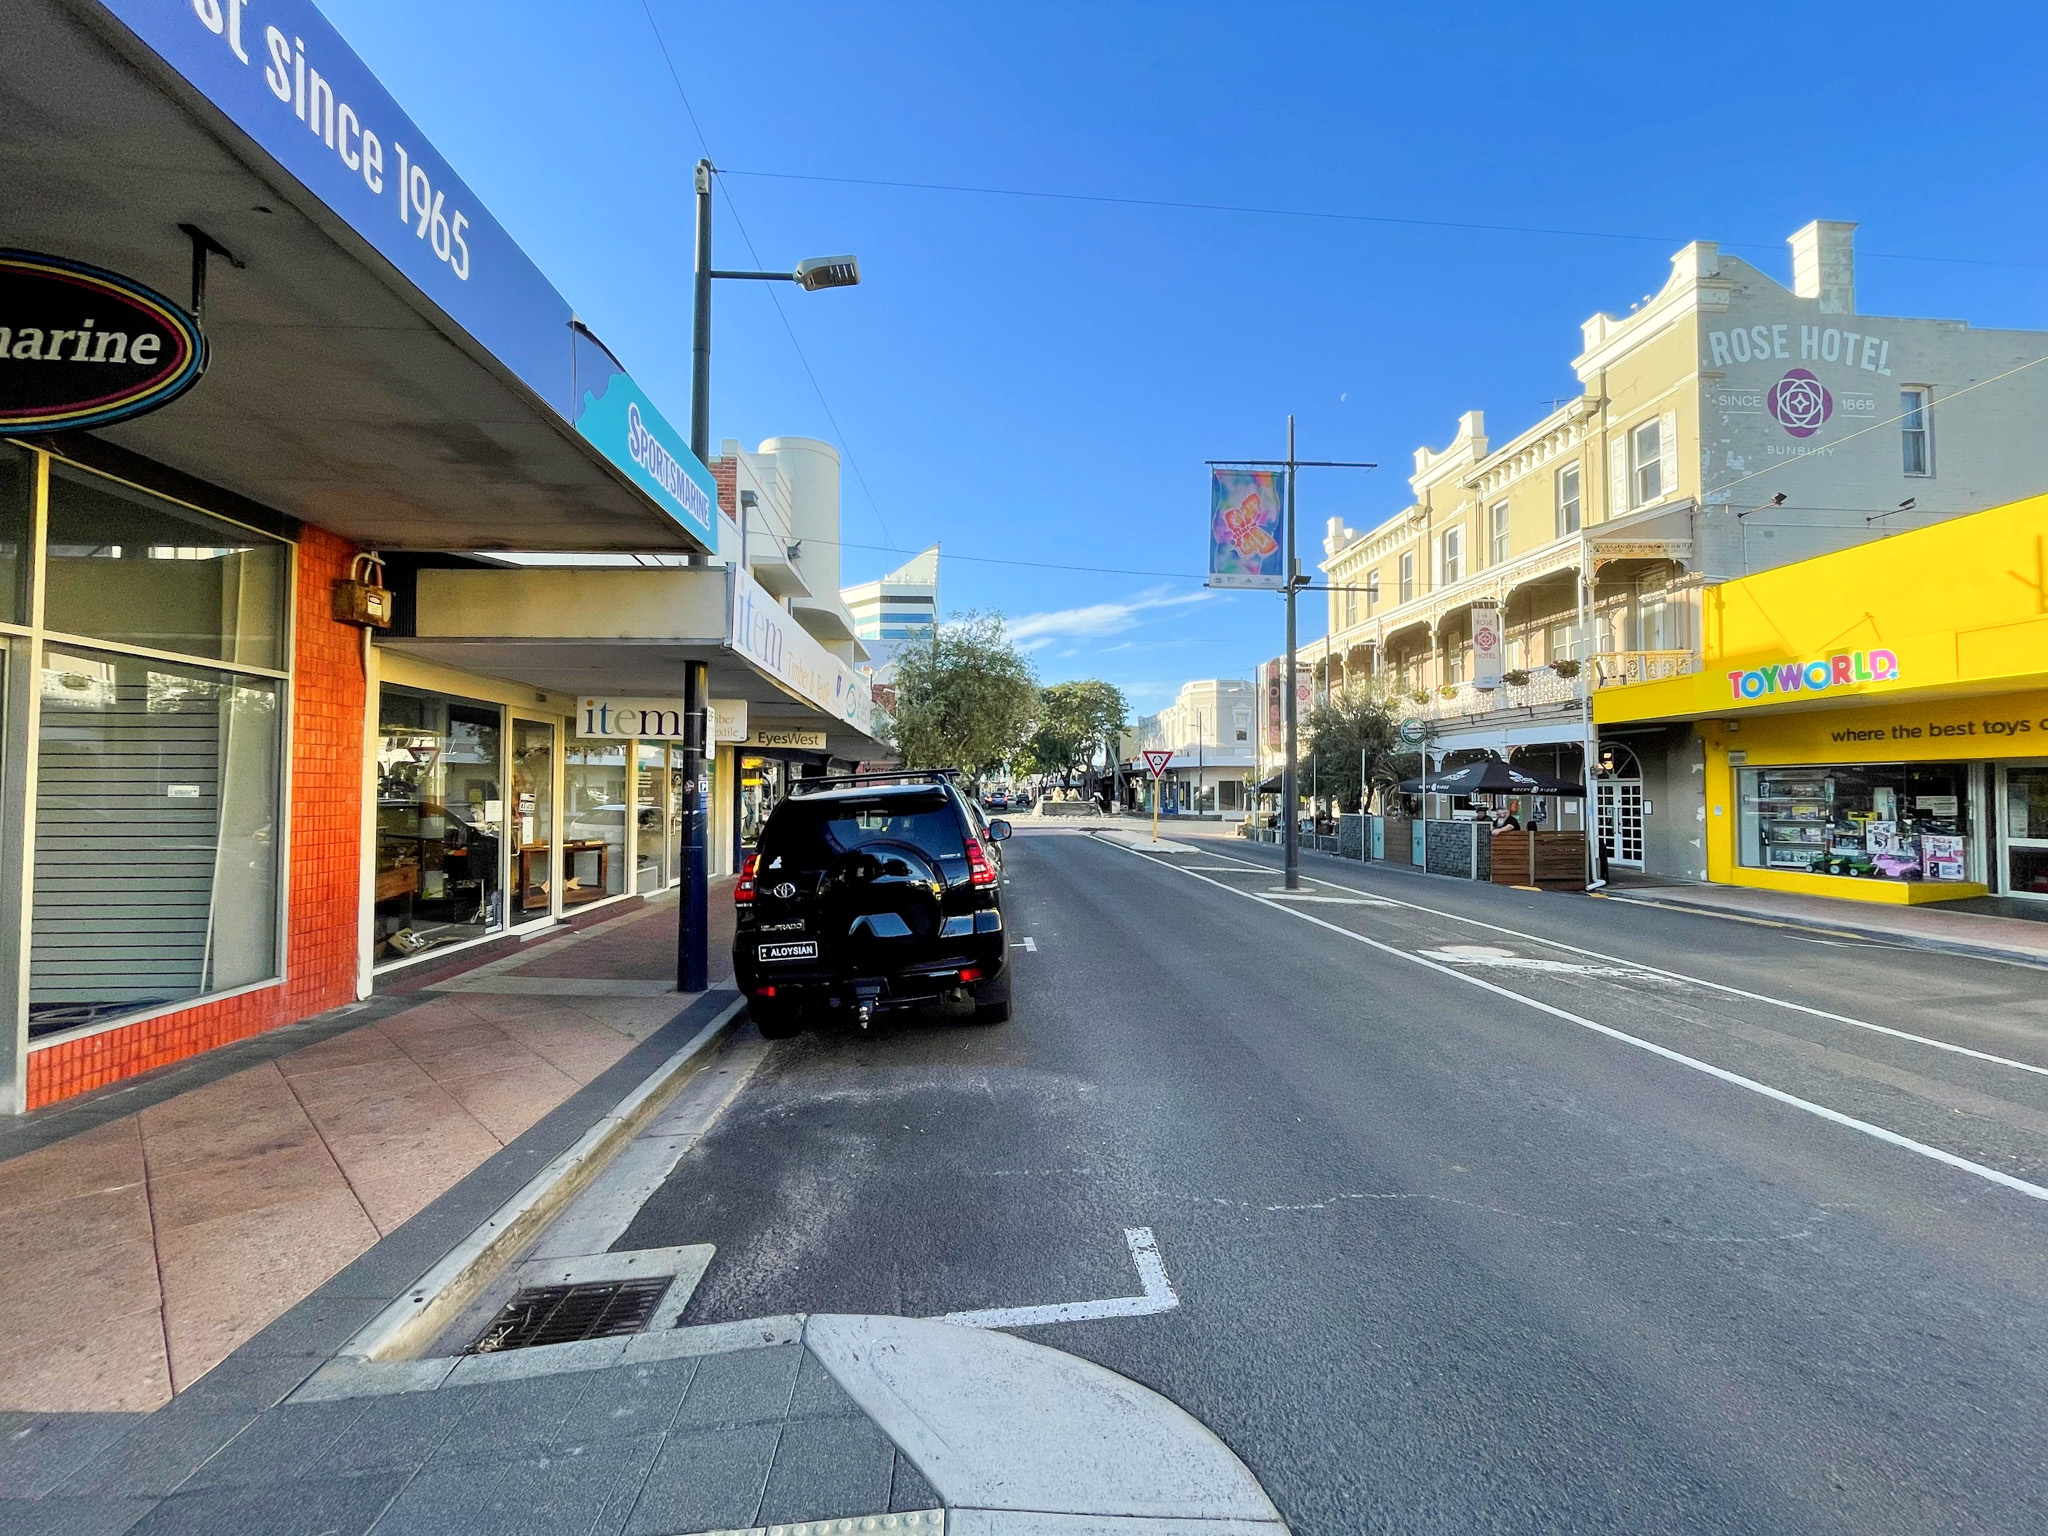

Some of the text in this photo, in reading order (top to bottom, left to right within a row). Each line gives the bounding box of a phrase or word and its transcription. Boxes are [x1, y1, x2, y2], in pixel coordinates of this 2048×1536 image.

[266, 26, 383, 194] since
[395, 141, 469, 281] 1965
[0, 318, 161, 365] arine
[1709, 324, 1892, 376] ROSE HOTEL
[1718, 394, 1875, 411] SINCE 1865
[629, 403, 710, 530] SPORTSMARINE
[1766, 445, 1835, 457] BUNBURY
[737, 576, 783, 672] item
[1728, 650, 1898, 699] TOYWORLD
[584, 699, 682, 736] item
[715, 713, 735, 724] ber
[1269, 664, 1280, 745] ROSE
[715, 726, 739, 737] extile
[758, 731, 820, 746] EyesWest
[1831, 728, 1885, 742] where
[1892, 725, 1922, 739] the
[1929, 721, 1976, 737] best
[1982, 719, 2031, 736] toys
[771, 946, 813, 957] ALOYSIAN
